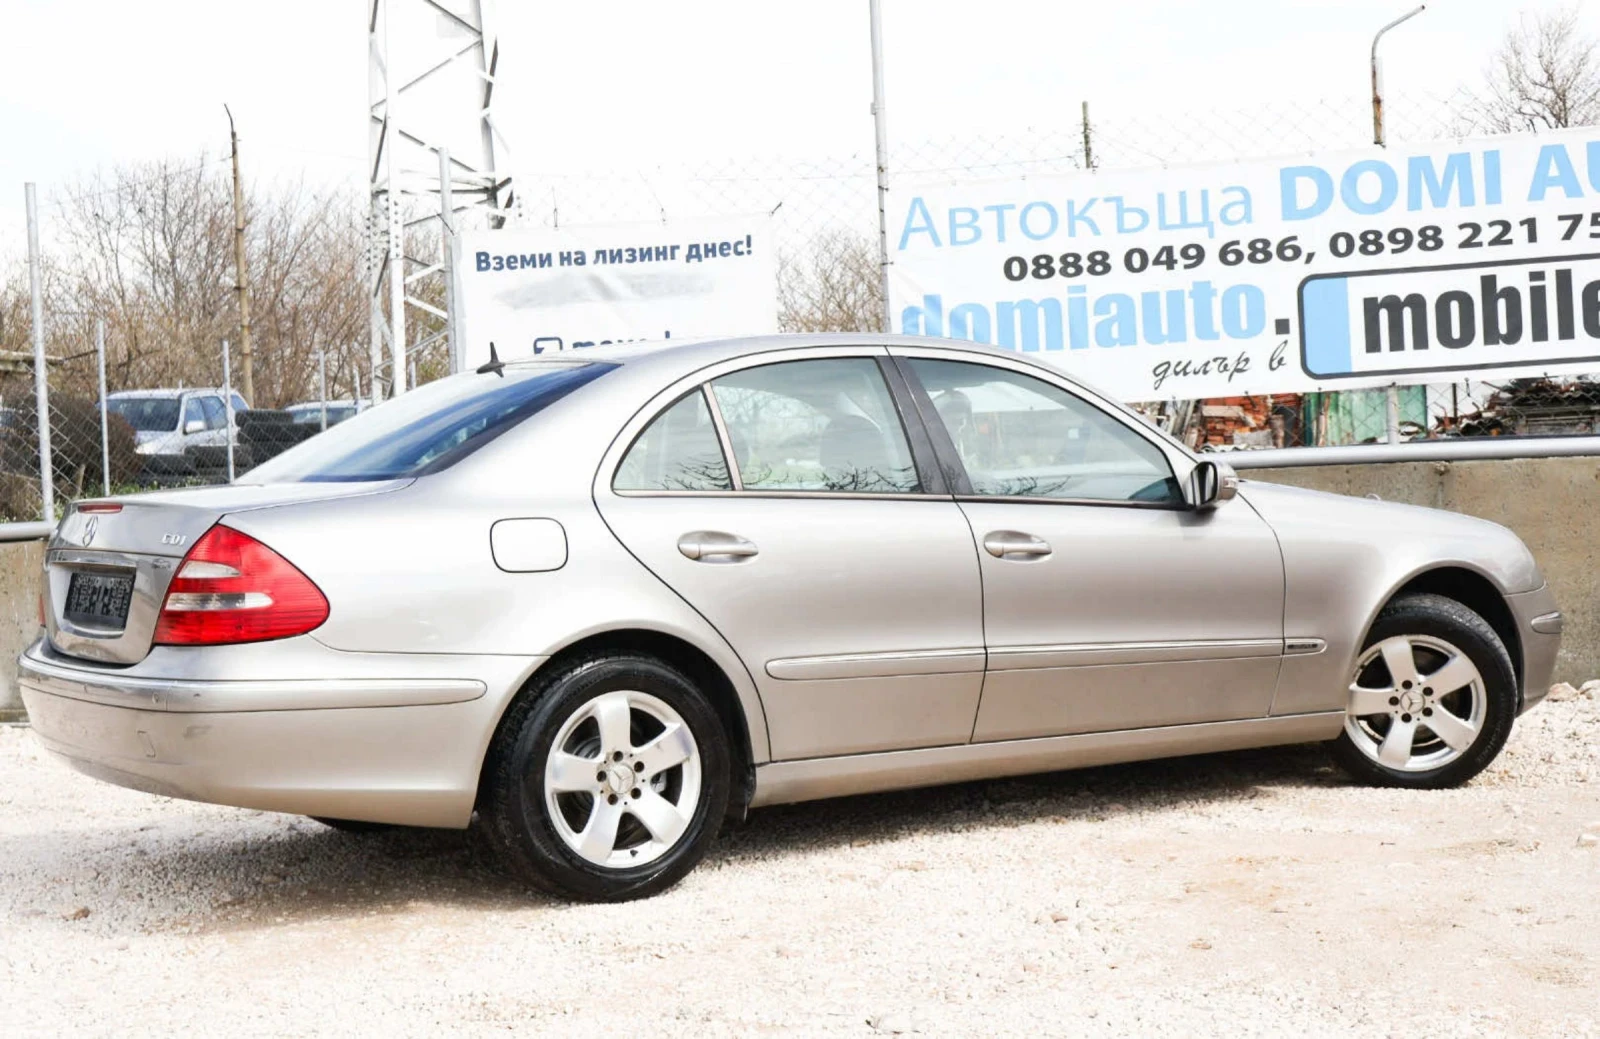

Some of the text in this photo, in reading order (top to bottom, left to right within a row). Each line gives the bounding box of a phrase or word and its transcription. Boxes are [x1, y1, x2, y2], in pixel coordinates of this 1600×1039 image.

[1279, 149, 1503, 222] DOMI
[898, 184, 1254, 251] Автокъща
[475, 234, 752, 272] Вземи на лизинг днес!
[1003, 250, 1113, 282] 0888
[1123, 243, 1206, 274] 049
[1218, 235, 1316, 266] 686,
[1329, 225, 1445, 259] 0898
[1457, 217, 1538, 250] 221
[1152, 350, 1251, 390] дилър
[161, 533, 187, 546] CDI
